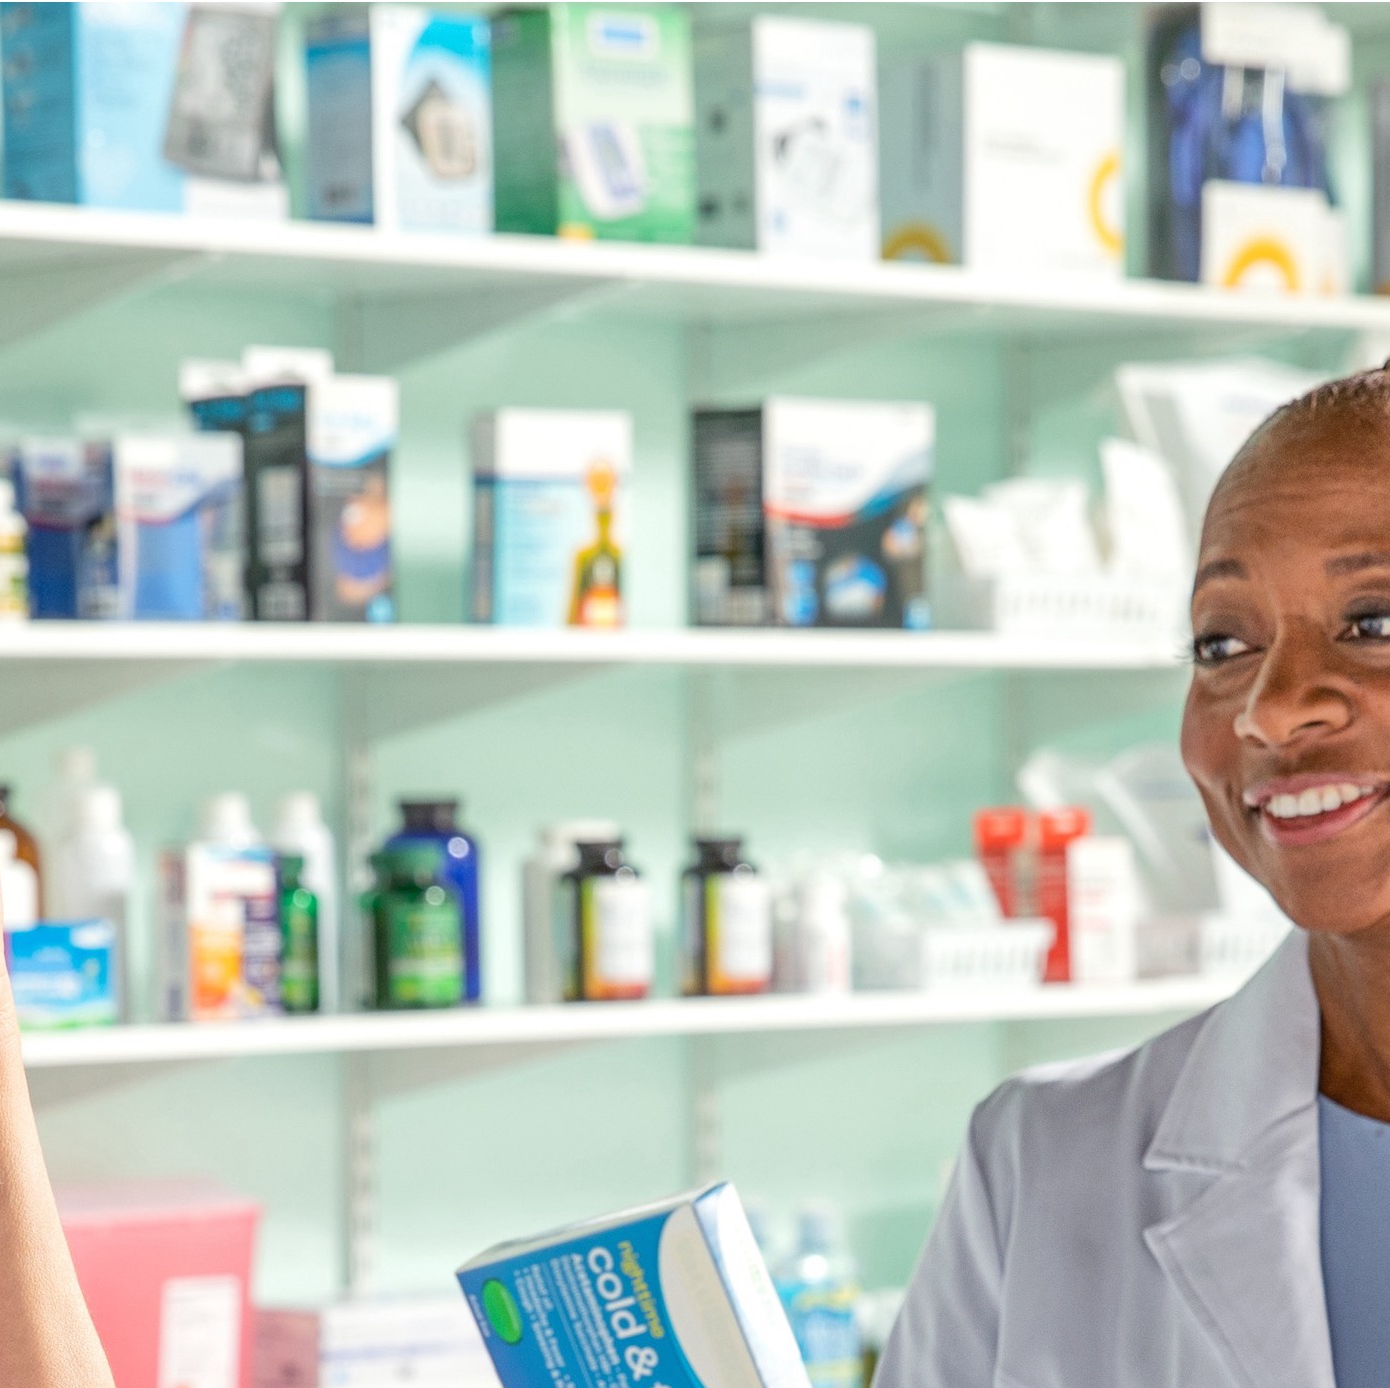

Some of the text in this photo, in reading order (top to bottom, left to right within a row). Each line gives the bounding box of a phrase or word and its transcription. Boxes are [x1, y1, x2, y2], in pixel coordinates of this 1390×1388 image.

[569, 1252, 620, 1366] Acetaminophen
[585, 1245, 646, 1343] cold
[624, 1345, 658, 1382] &
[617, 1241, 665, 1339] nighttime
